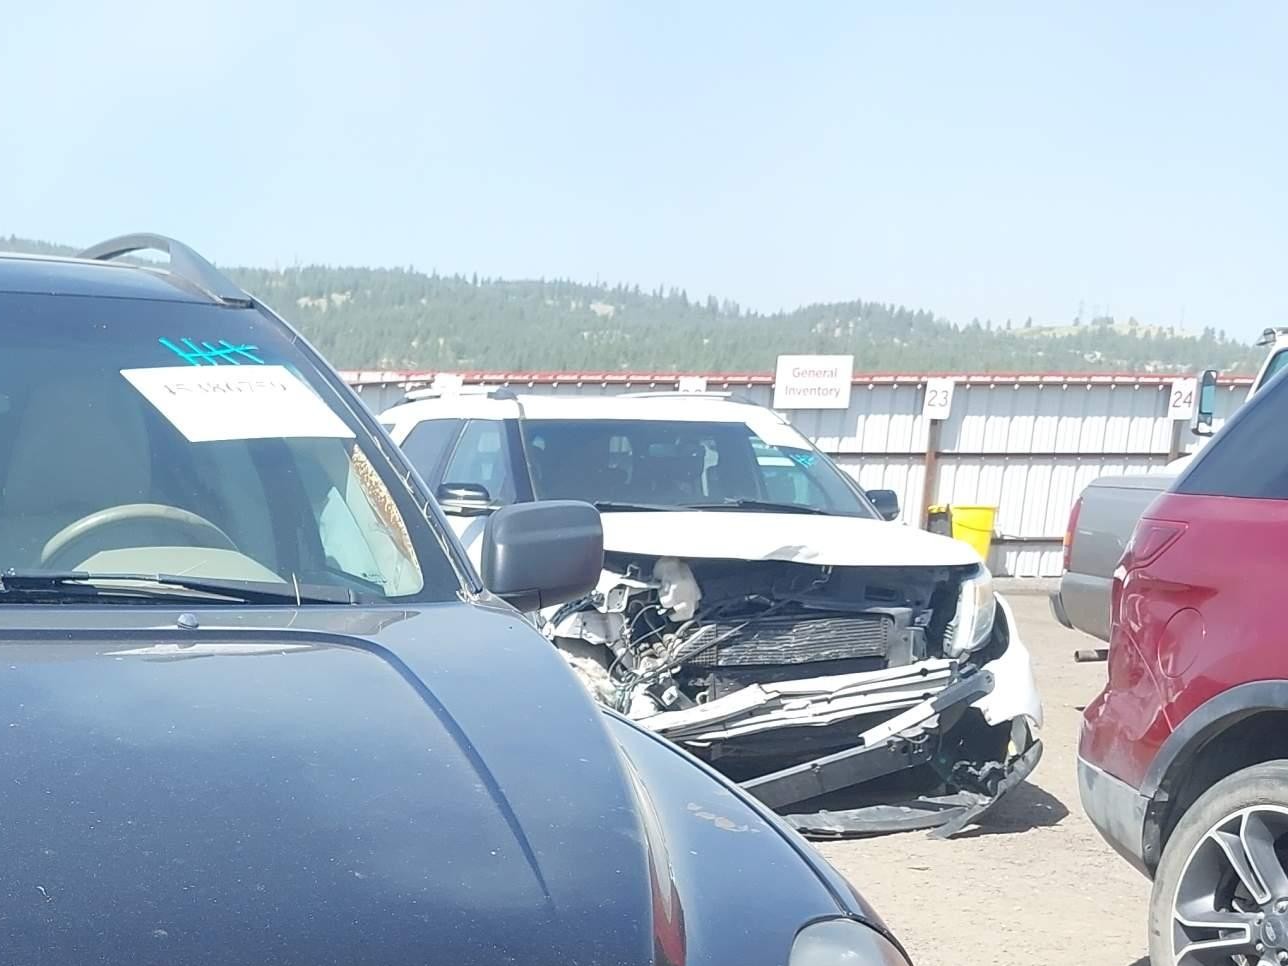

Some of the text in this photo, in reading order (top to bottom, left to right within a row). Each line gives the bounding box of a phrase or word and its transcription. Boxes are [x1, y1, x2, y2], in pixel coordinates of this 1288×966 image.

[792, 367, 838, 378] General
[784, 385, 841, 398] Inventory
[927, 389, 949, 407] 23
[1172, 390, 1193, 408] 24
